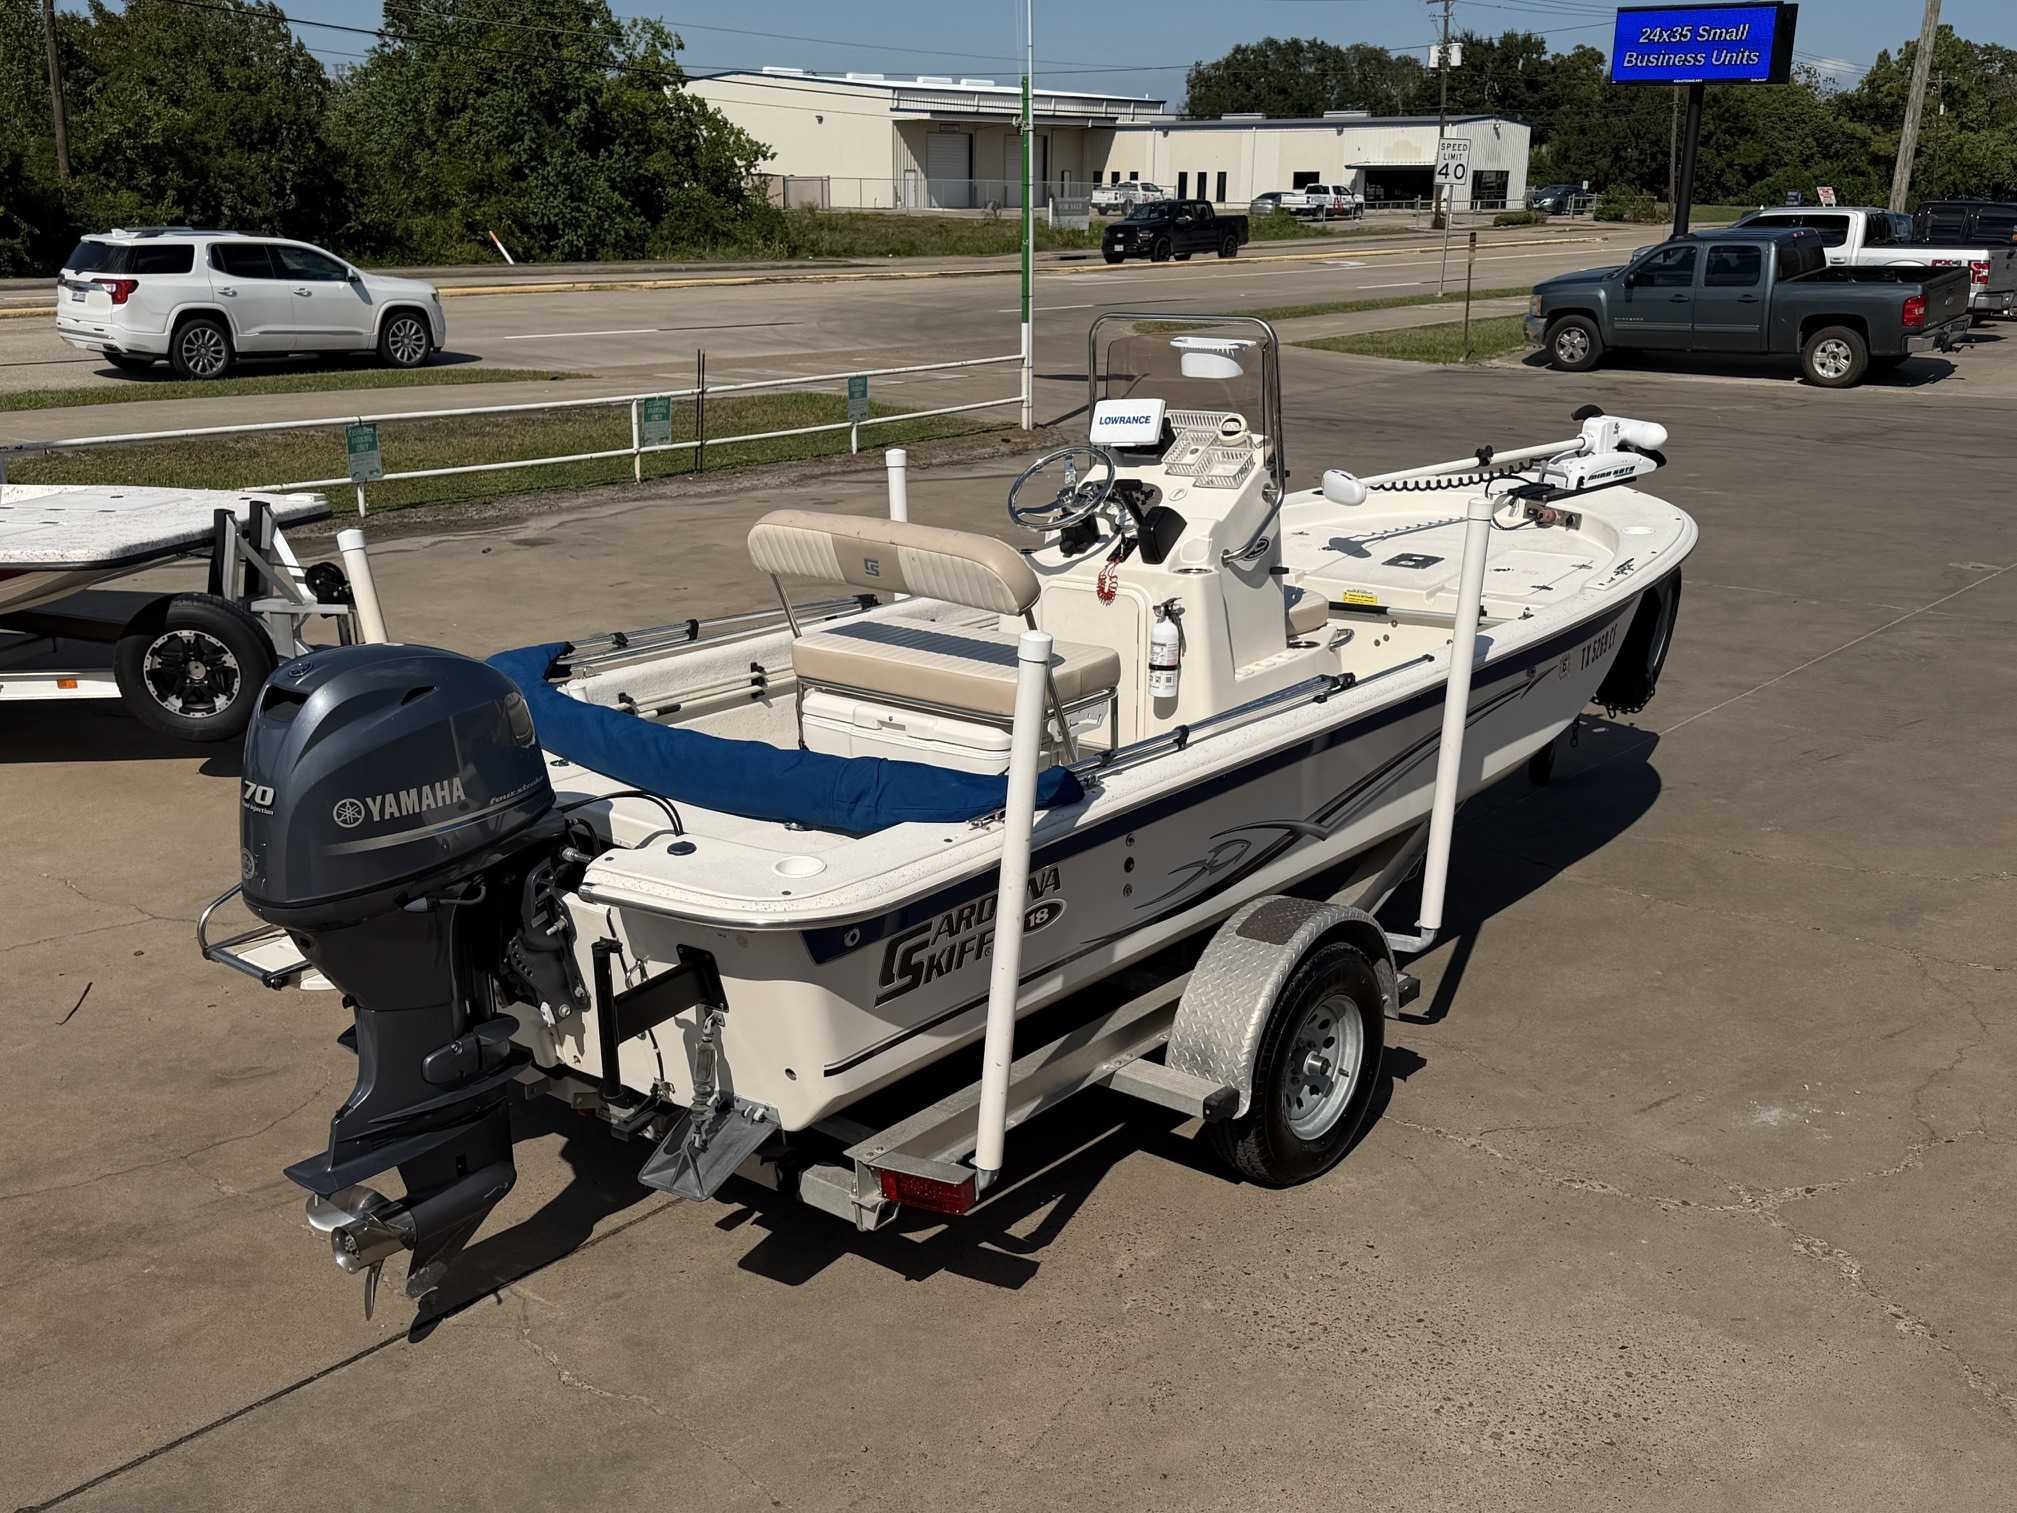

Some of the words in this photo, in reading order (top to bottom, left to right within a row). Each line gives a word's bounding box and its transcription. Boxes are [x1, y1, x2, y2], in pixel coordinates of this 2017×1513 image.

[1639, 26, 1692, 43] 24x35
[1697, 24, 1749, 41] Small
[1624, 50, 1706, 67] Business
[1711, 48, 1760, 65] Units
[1440, 143, 1468, 151] SPEED
[1443, 153, 1463, 161] LIMIT
[1437, 162, 1466, 180] 40
[1099, 415, 1152, 425] LOWRANCE
[244, 780, 275, 806] 70
[366, 777, 466, 822] YAMAHA
[1026, 906, 1050, 928] 18
